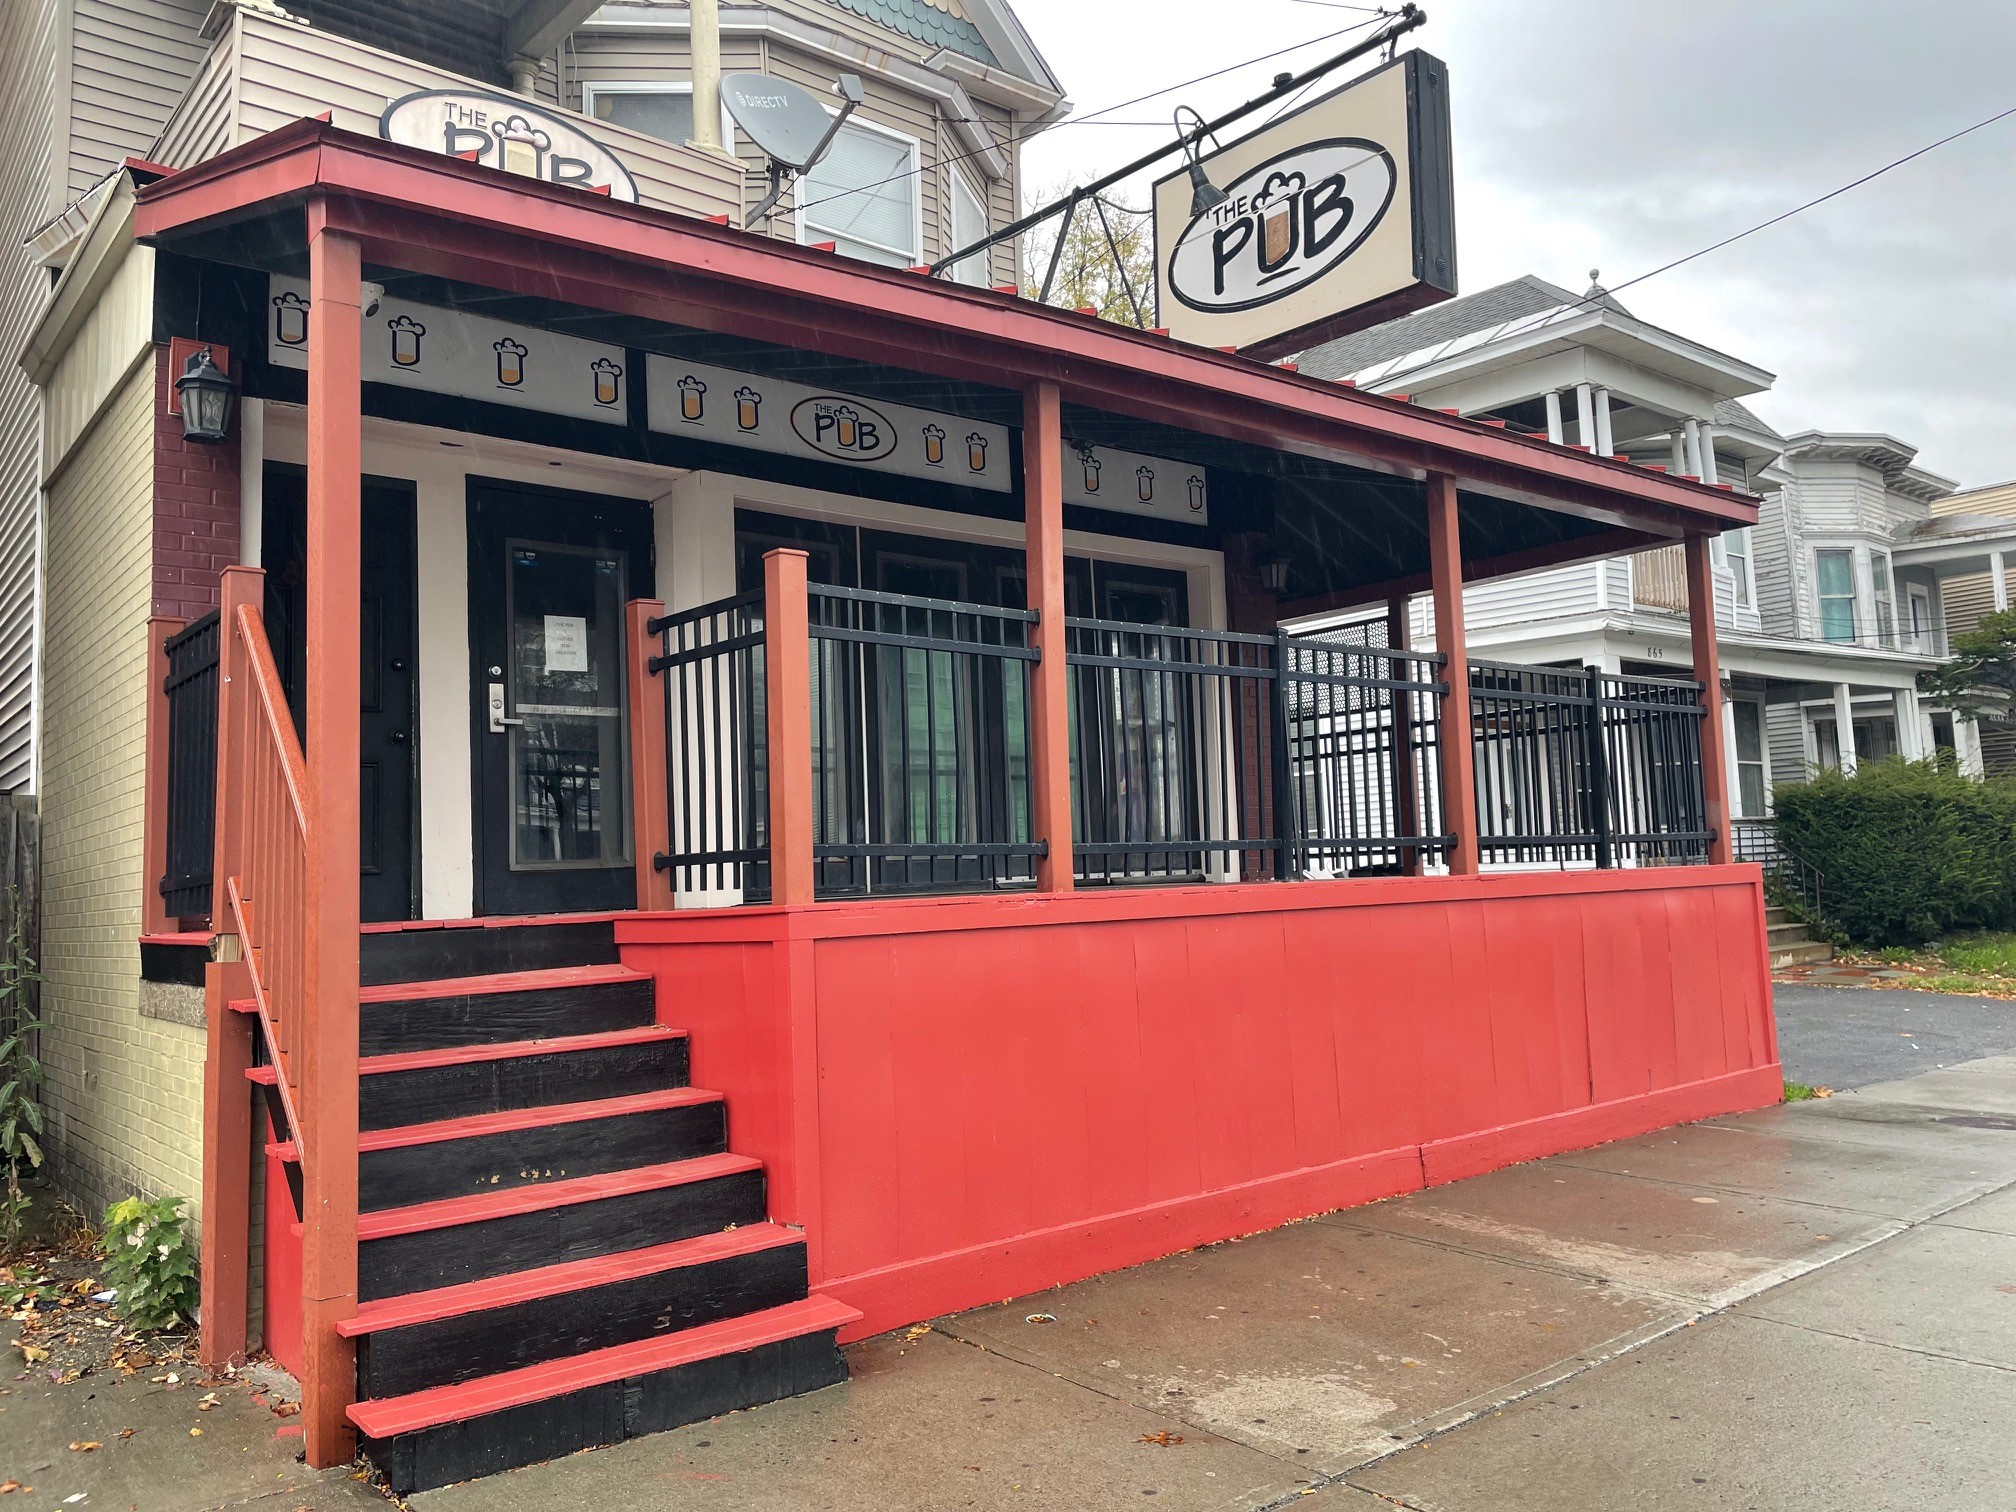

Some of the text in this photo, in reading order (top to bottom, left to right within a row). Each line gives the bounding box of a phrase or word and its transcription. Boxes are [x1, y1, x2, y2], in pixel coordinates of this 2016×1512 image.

[745, 95, 788, 108] DIRECTV
[444, 102, 488, 130] THE
[1213, 195, 1248, 226] THE
[1213, 171, 1354, 296] PUB
[814, 403, 833, 415] THE
[814, 405, 880, 451] PUB
[1647, 647, 1663, 659] 865
